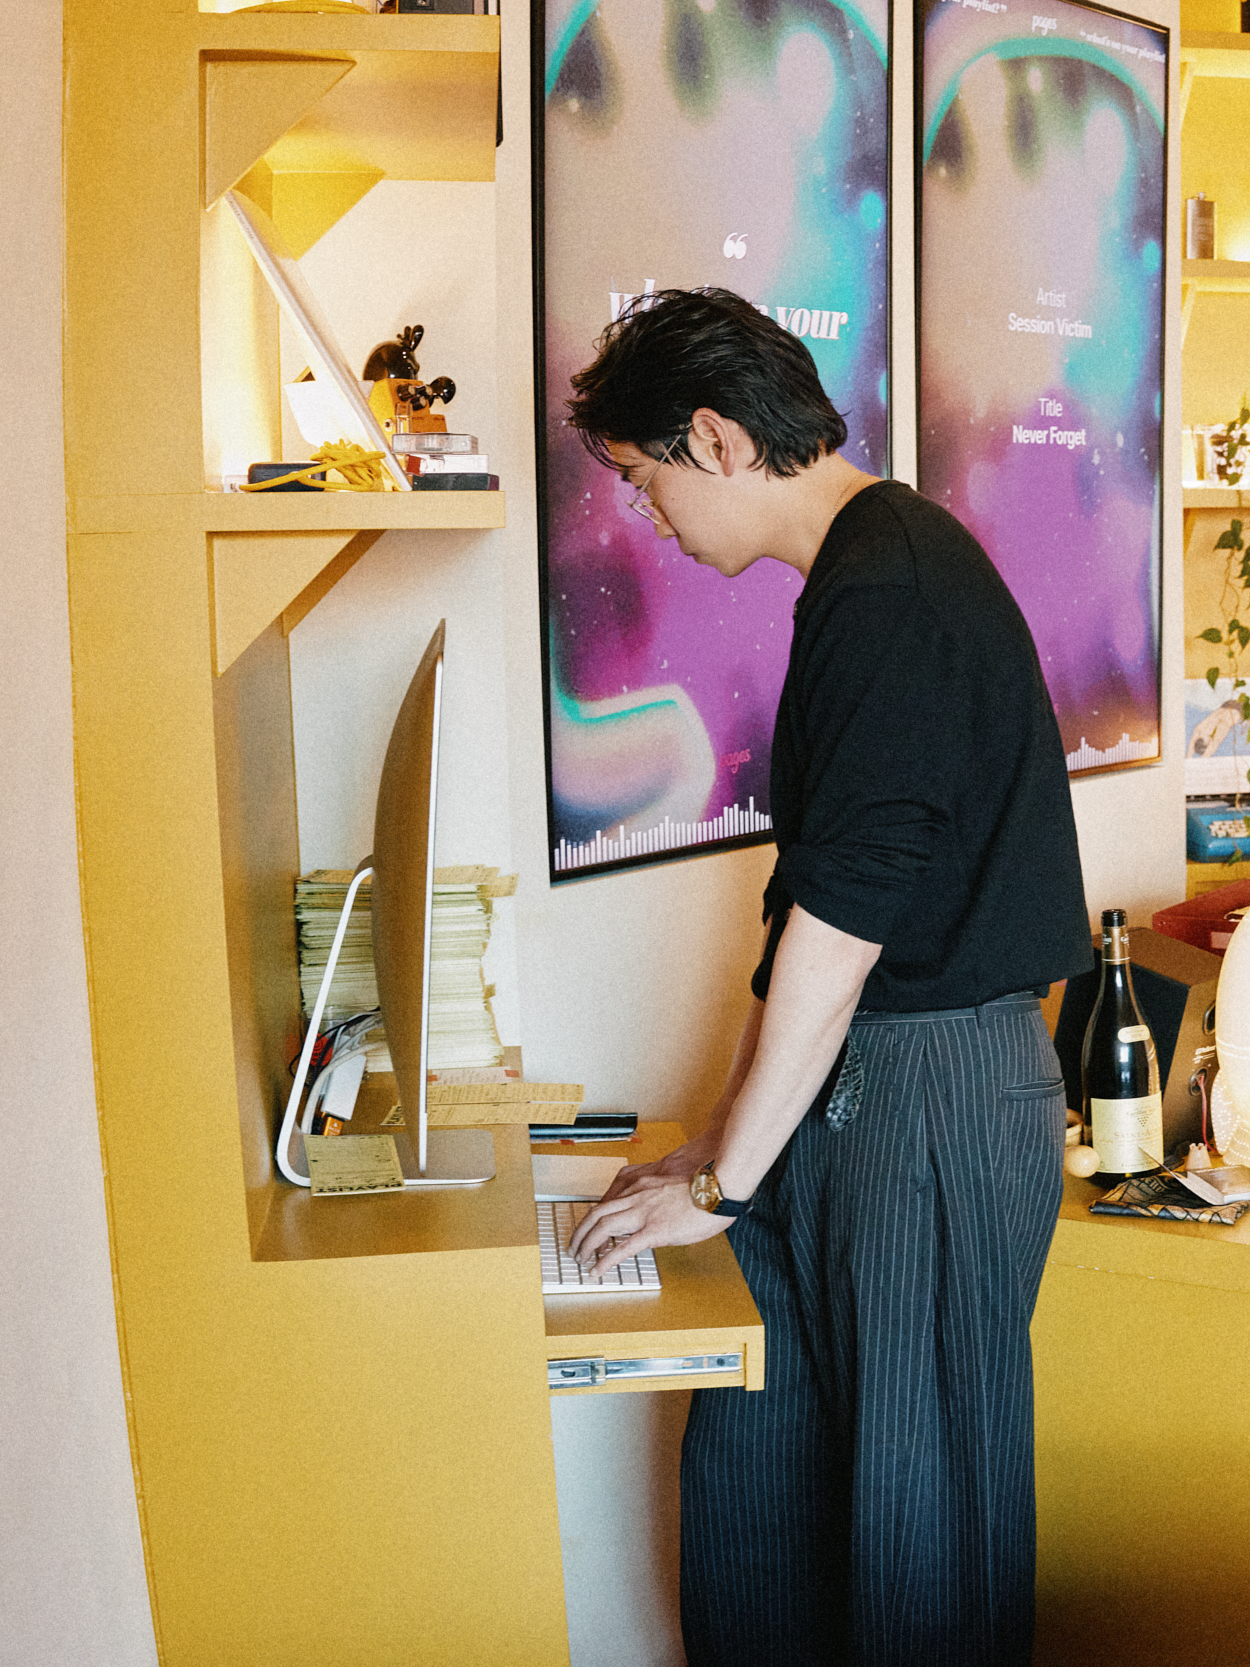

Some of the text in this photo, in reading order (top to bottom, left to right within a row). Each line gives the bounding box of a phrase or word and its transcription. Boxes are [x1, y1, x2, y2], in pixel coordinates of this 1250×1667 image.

[1036, 287, 1067, 308] Artist
[776, 305, 849, 340] your
[1008, 312, 1092, 339] Session Victim
[1038, 397, 1063, 417] Title
[1012, 424, 1087, 450] Never Forget
